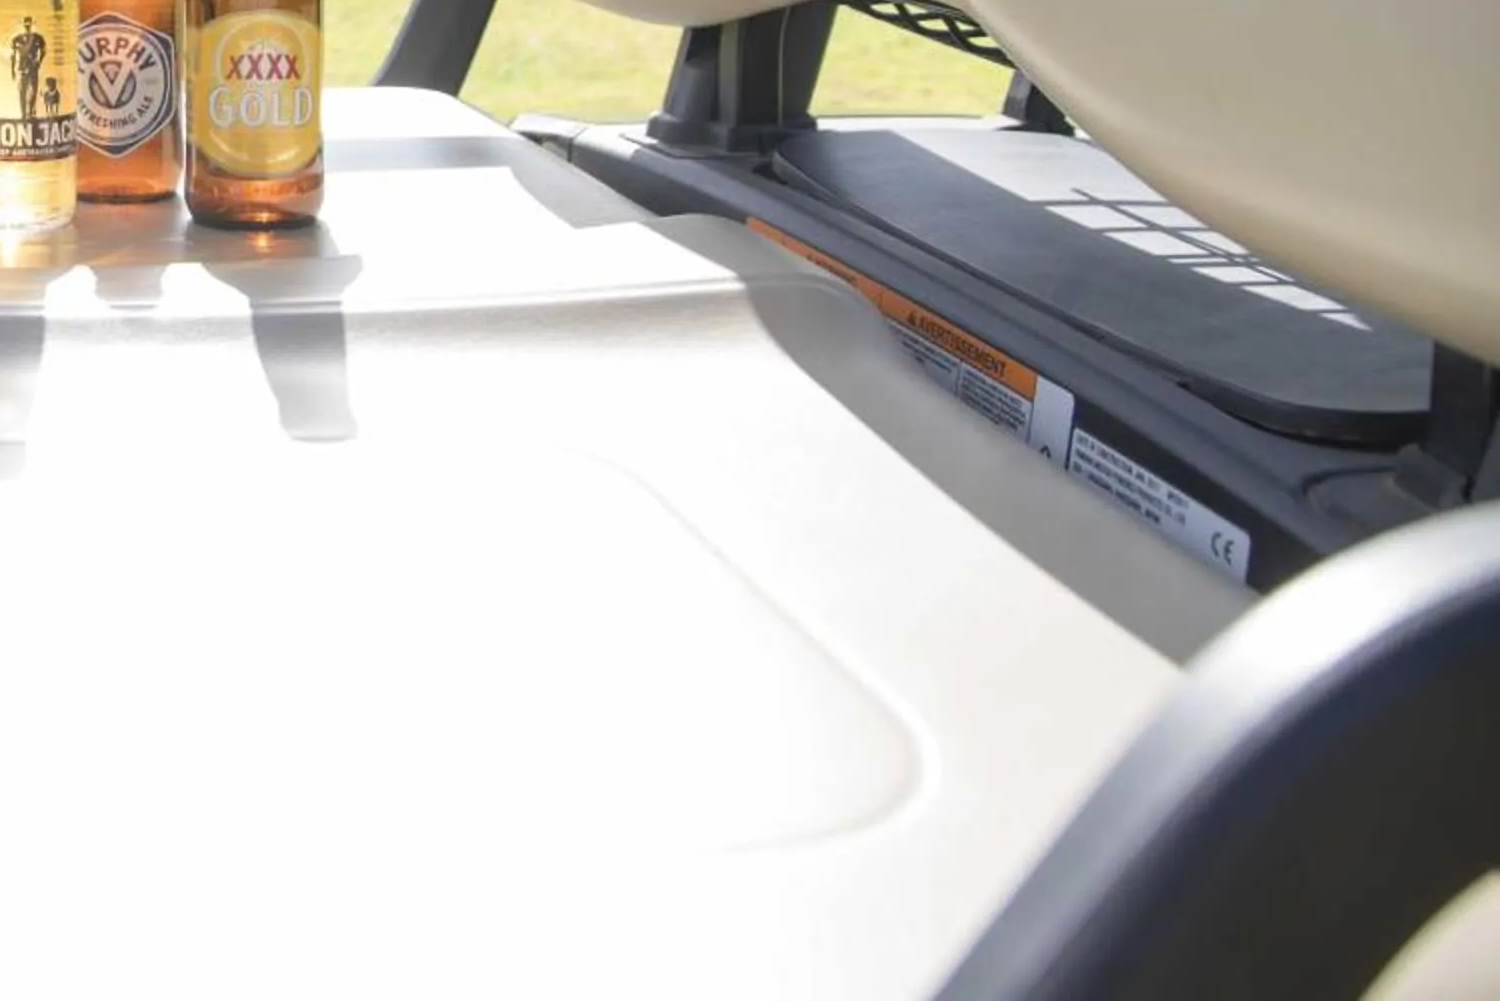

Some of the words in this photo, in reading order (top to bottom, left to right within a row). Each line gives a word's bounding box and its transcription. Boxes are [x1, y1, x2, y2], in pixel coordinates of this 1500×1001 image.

[77, 36, 157, 74] URPHY
[225, 53, 301, 81] XXXX
[208, 86, 313, 128] GOLD
